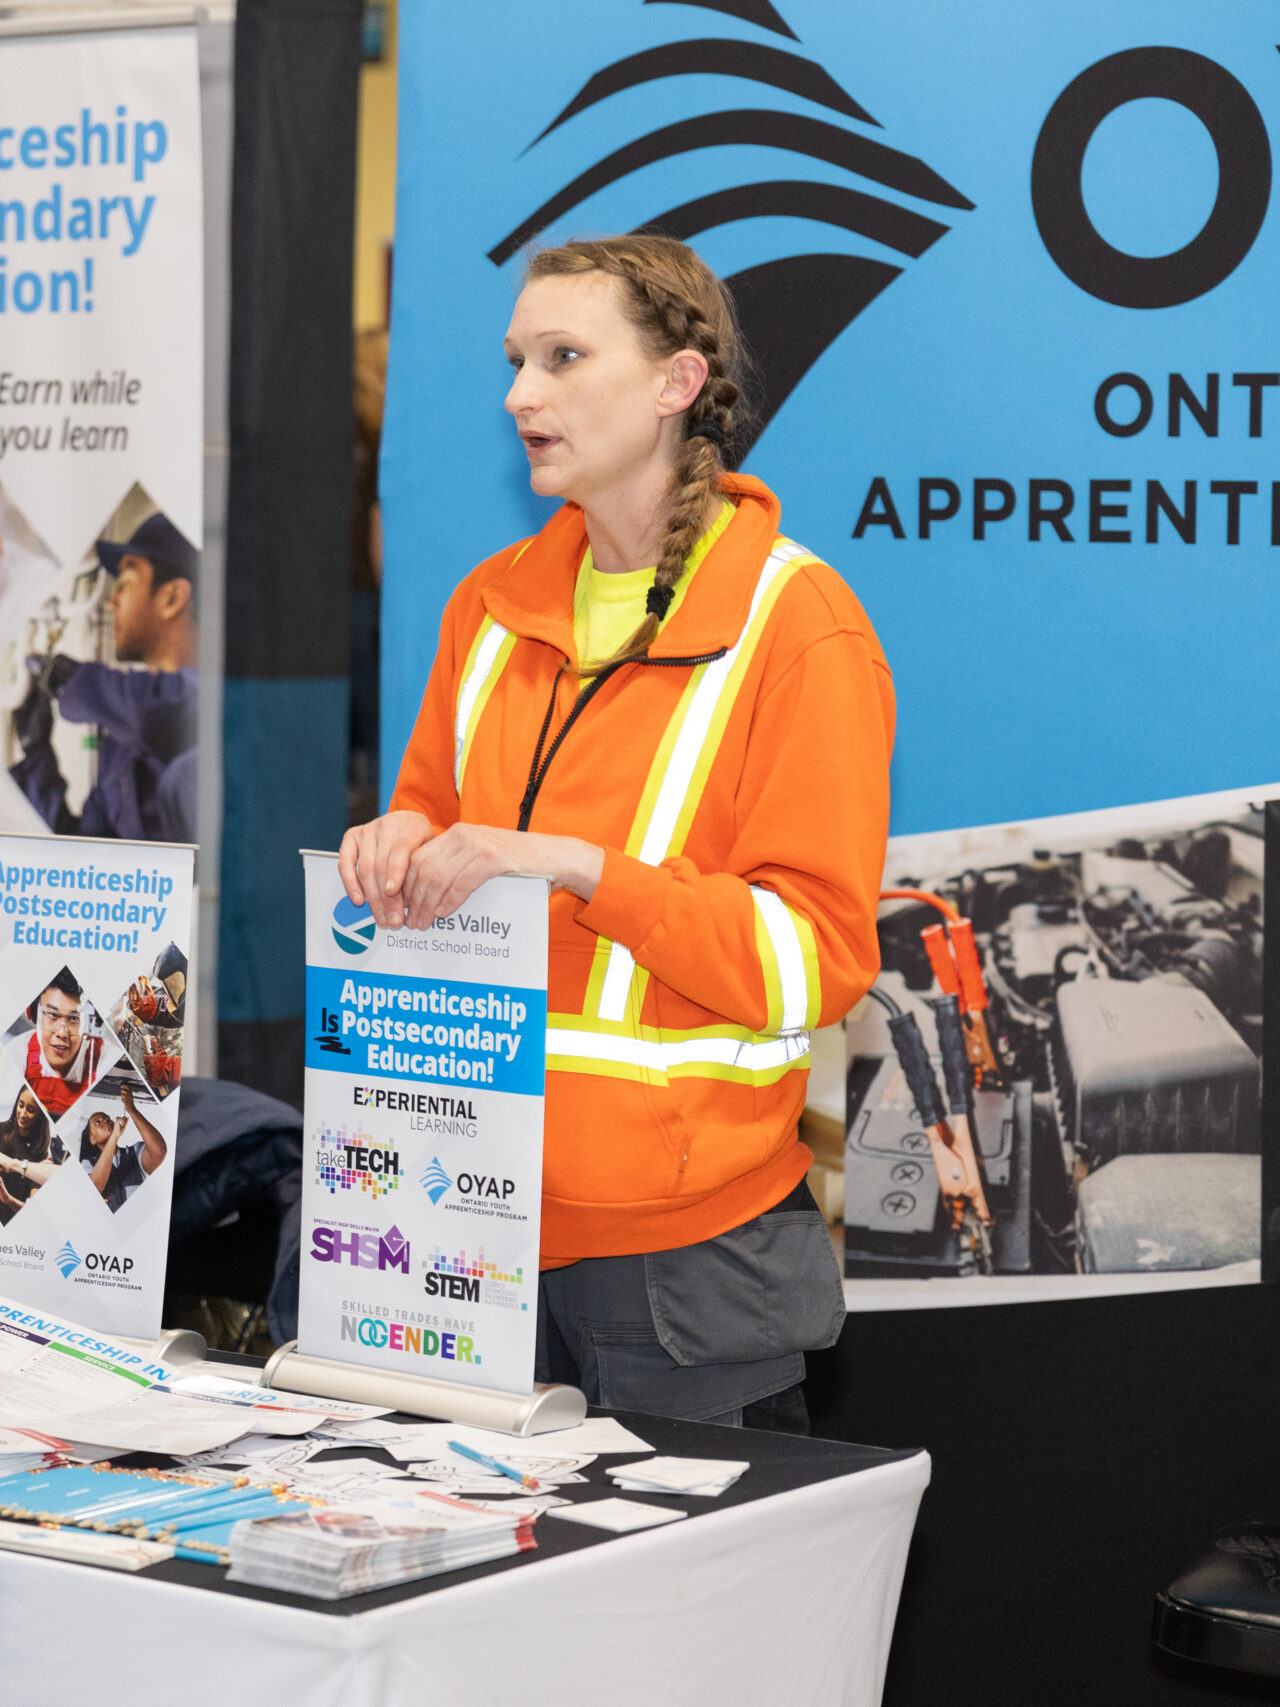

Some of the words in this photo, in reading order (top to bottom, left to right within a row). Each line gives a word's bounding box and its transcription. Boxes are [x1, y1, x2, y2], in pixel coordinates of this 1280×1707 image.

[69, 369, 141, 406] while
[1094, 371, 1280, 438] ONT
[60, 418, 129, 452] learn
[13, 921, 139, 953] Education!
[458, 914, 511, 939] Valley
[387, 935, 428, 951] District
[431, 939, 471, 954] School
[475, 944, 510, 958] Board
[340, 979, 527, 1030] Apprenticeship
[321, 1007, 338, 1033] Is
[342, 1010, 521, 1062] Postsecondary
[367, 1043, 494, 1083] Education!
[353, 1086, 477, 1120] EXPERIENTIAL
[410, 1116, 477, 1138] LEARNING
[457, 1173, 515, 1199] OYAP
[444, 1204, 495, 1216] APPRENTICESHIP
[496, 1211, 528, 1222] PROGRAM
[461, 1198, 488, 1208] ONTARIO
[490, 1201, 511, 1211] YOUTH
[14, 1245, 46, 1260] Valley
[310, 1226, 410, 1274] SHSM
[0, 1258, 22, 1268] School
[24, 1261, 44, 1271] Board
[85, 1253, 134, 1274] OYAP
[74, 1277, 116, 1288] APPRENTICESHIP
[118, 1283, 142, 1291] PROGRAM
[88, 1273, 110, 1281] ONTARIO
[425, 1271, 480, 1303] STEM
[342, 1300, 389, 1317] SKILLED
[395, 1309, 439, 1326] TRADES
[445, 1317, 475, 1332] HAVE
[142, 1363, 172, 1381] IN
